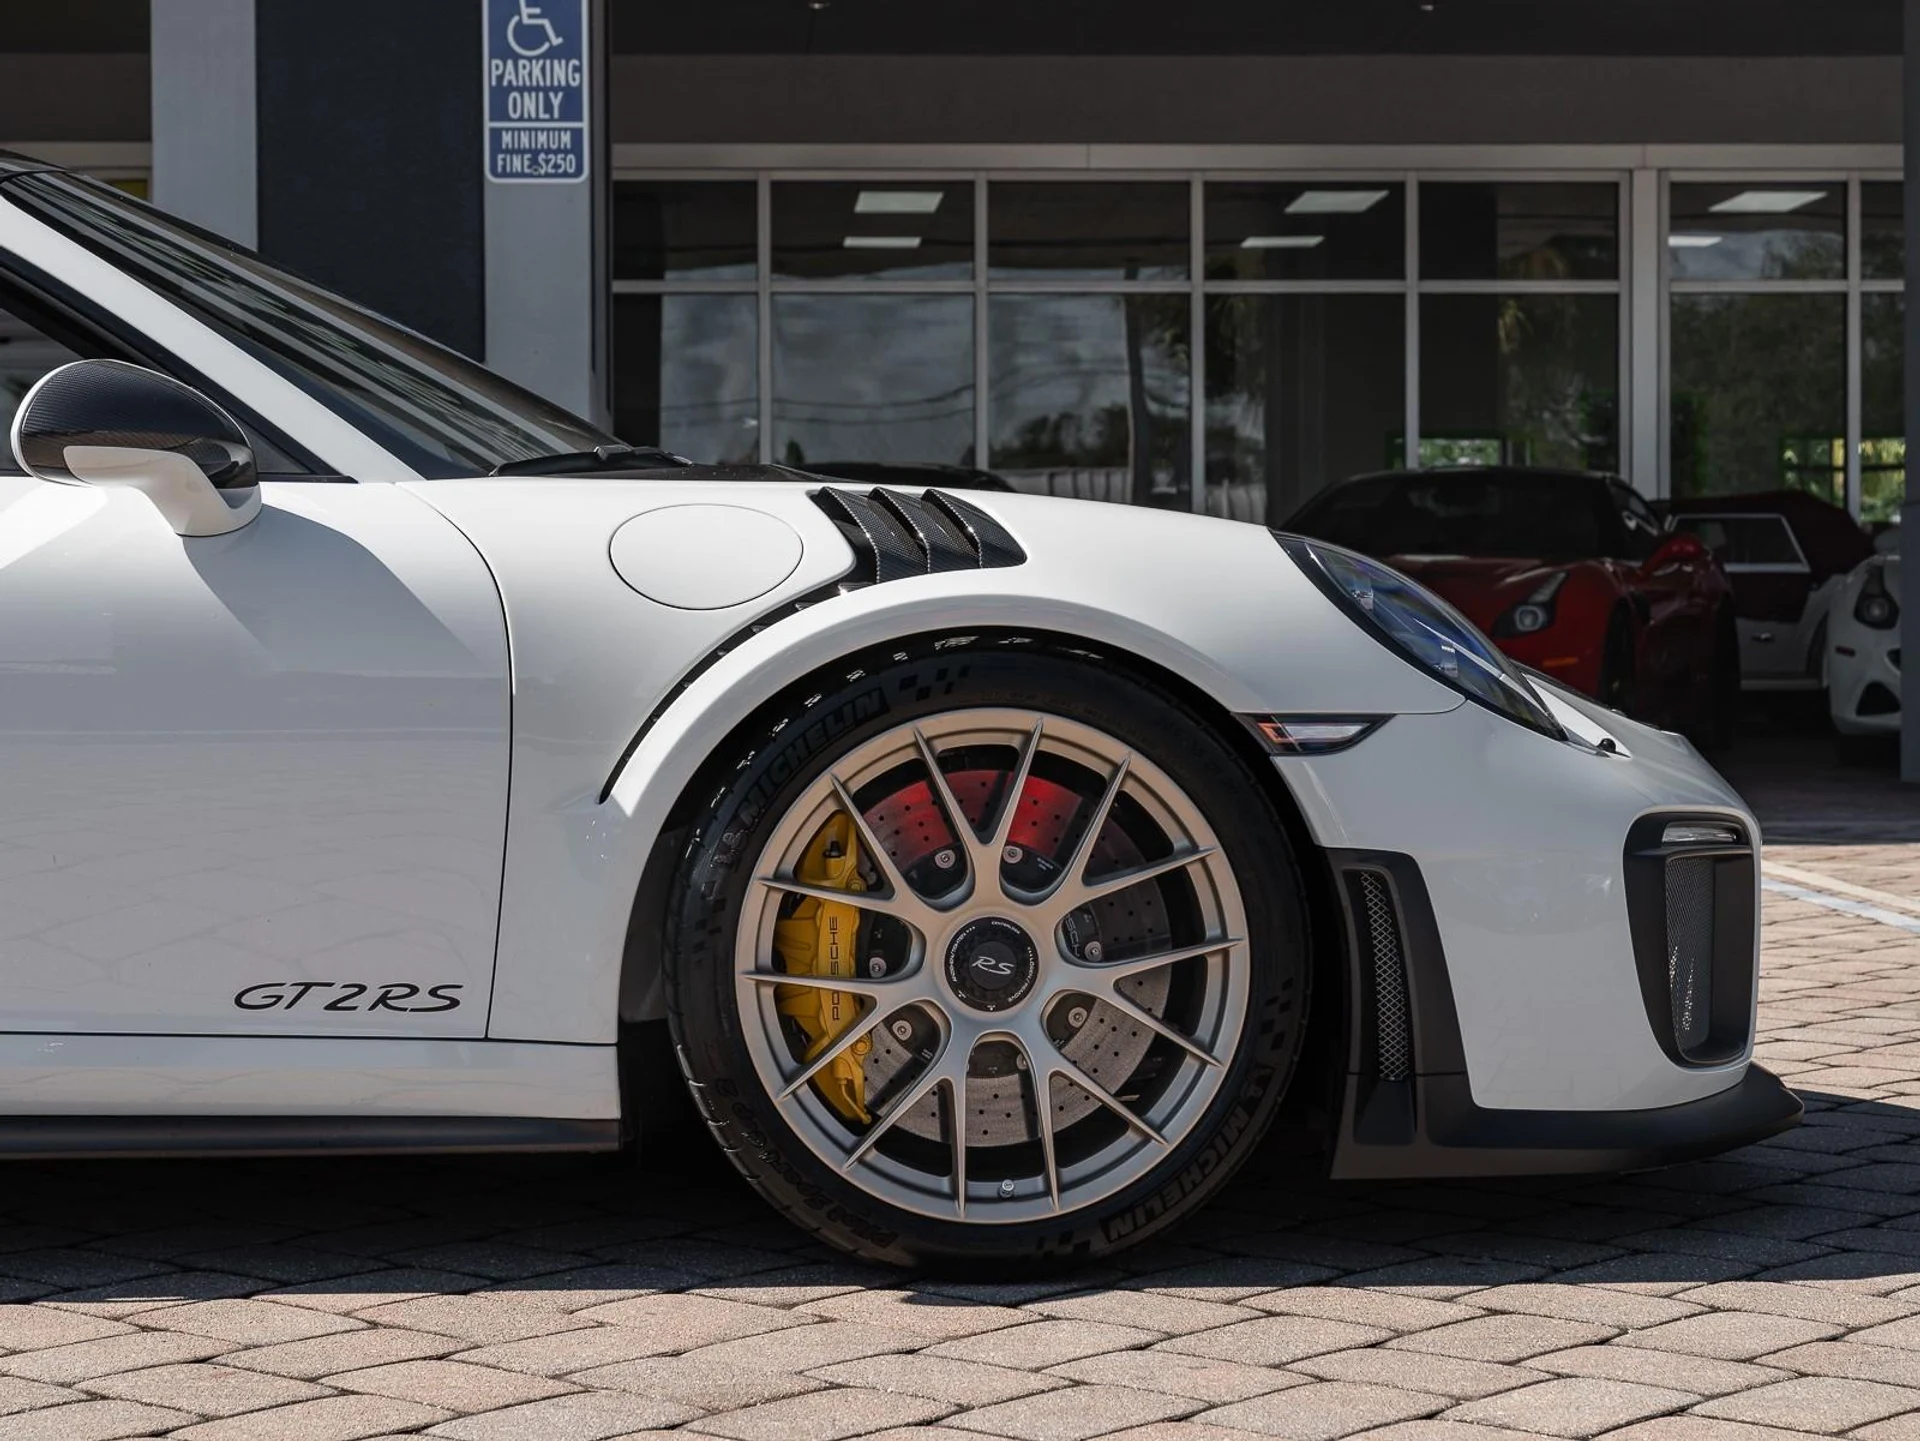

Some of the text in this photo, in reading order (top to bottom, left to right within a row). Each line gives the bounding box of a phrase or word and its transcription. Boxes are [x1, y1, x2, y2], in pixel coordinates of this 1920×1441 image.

[491, 59, 581, 87] PARKING
[507, 91, 564, 120] ONLY
[501, 130, 572, 150] MINIMUM
[497, 152, 576, 175] FINE $250
[736, 688, 884, 825] MICHELIN
[829, 915, 840, 1021] POSCHE
[972, 956, 1015, 975] RS
[1106, 1105, 1251, 1240] MICHELIN
